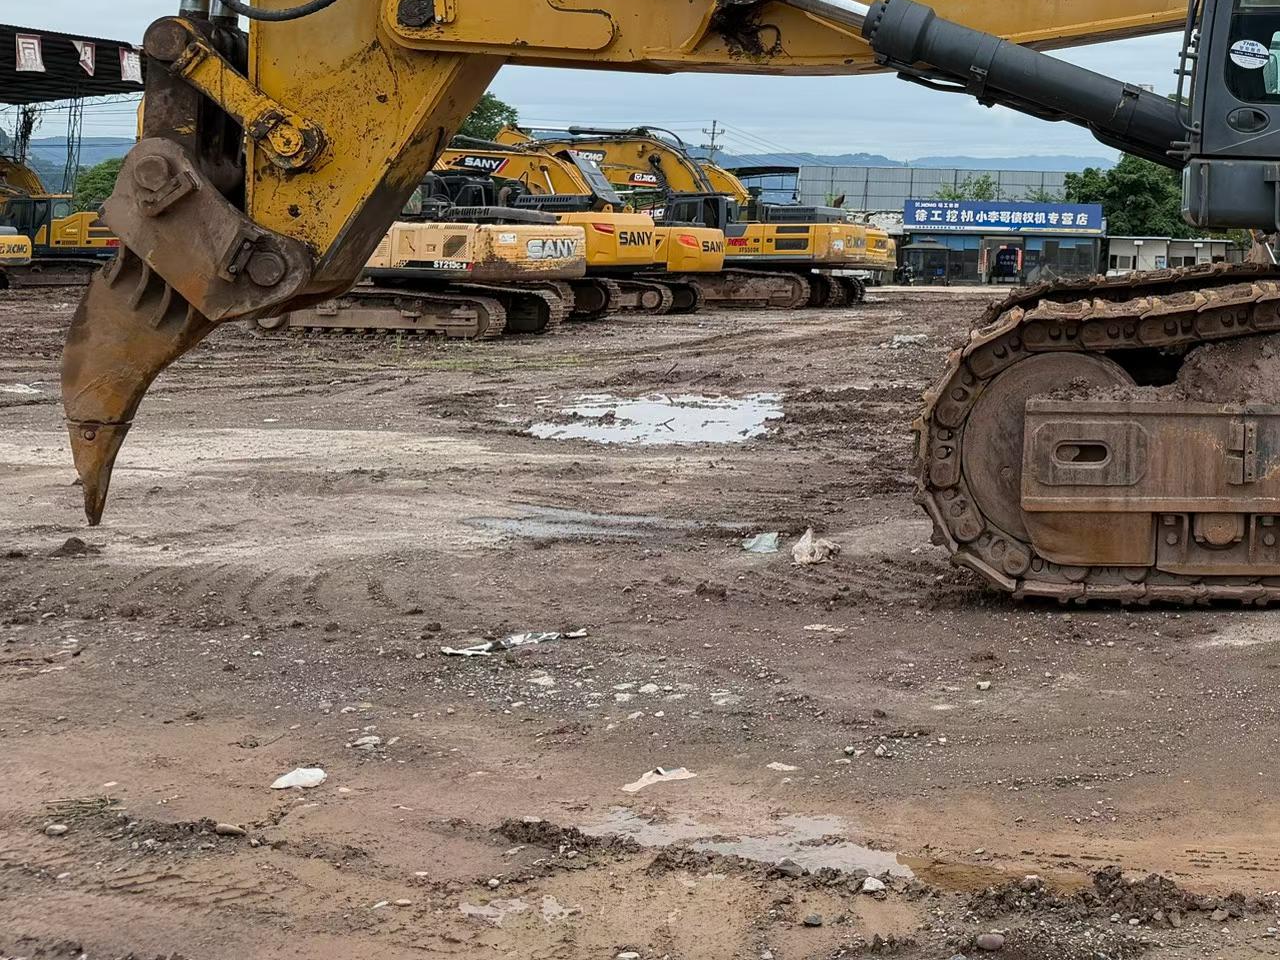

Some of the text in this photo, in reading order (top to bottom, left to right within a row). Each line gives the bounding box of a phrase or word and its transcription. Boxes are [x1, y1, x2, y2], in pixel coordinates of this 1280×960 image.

[576, 151, 603, 161] XCMG
[464, 157, 500, 170] SANY
[619, 231, 652, 246] SANY
[527, 239, 579, 259] SANY
[702, 240, 724, 253] SANY
